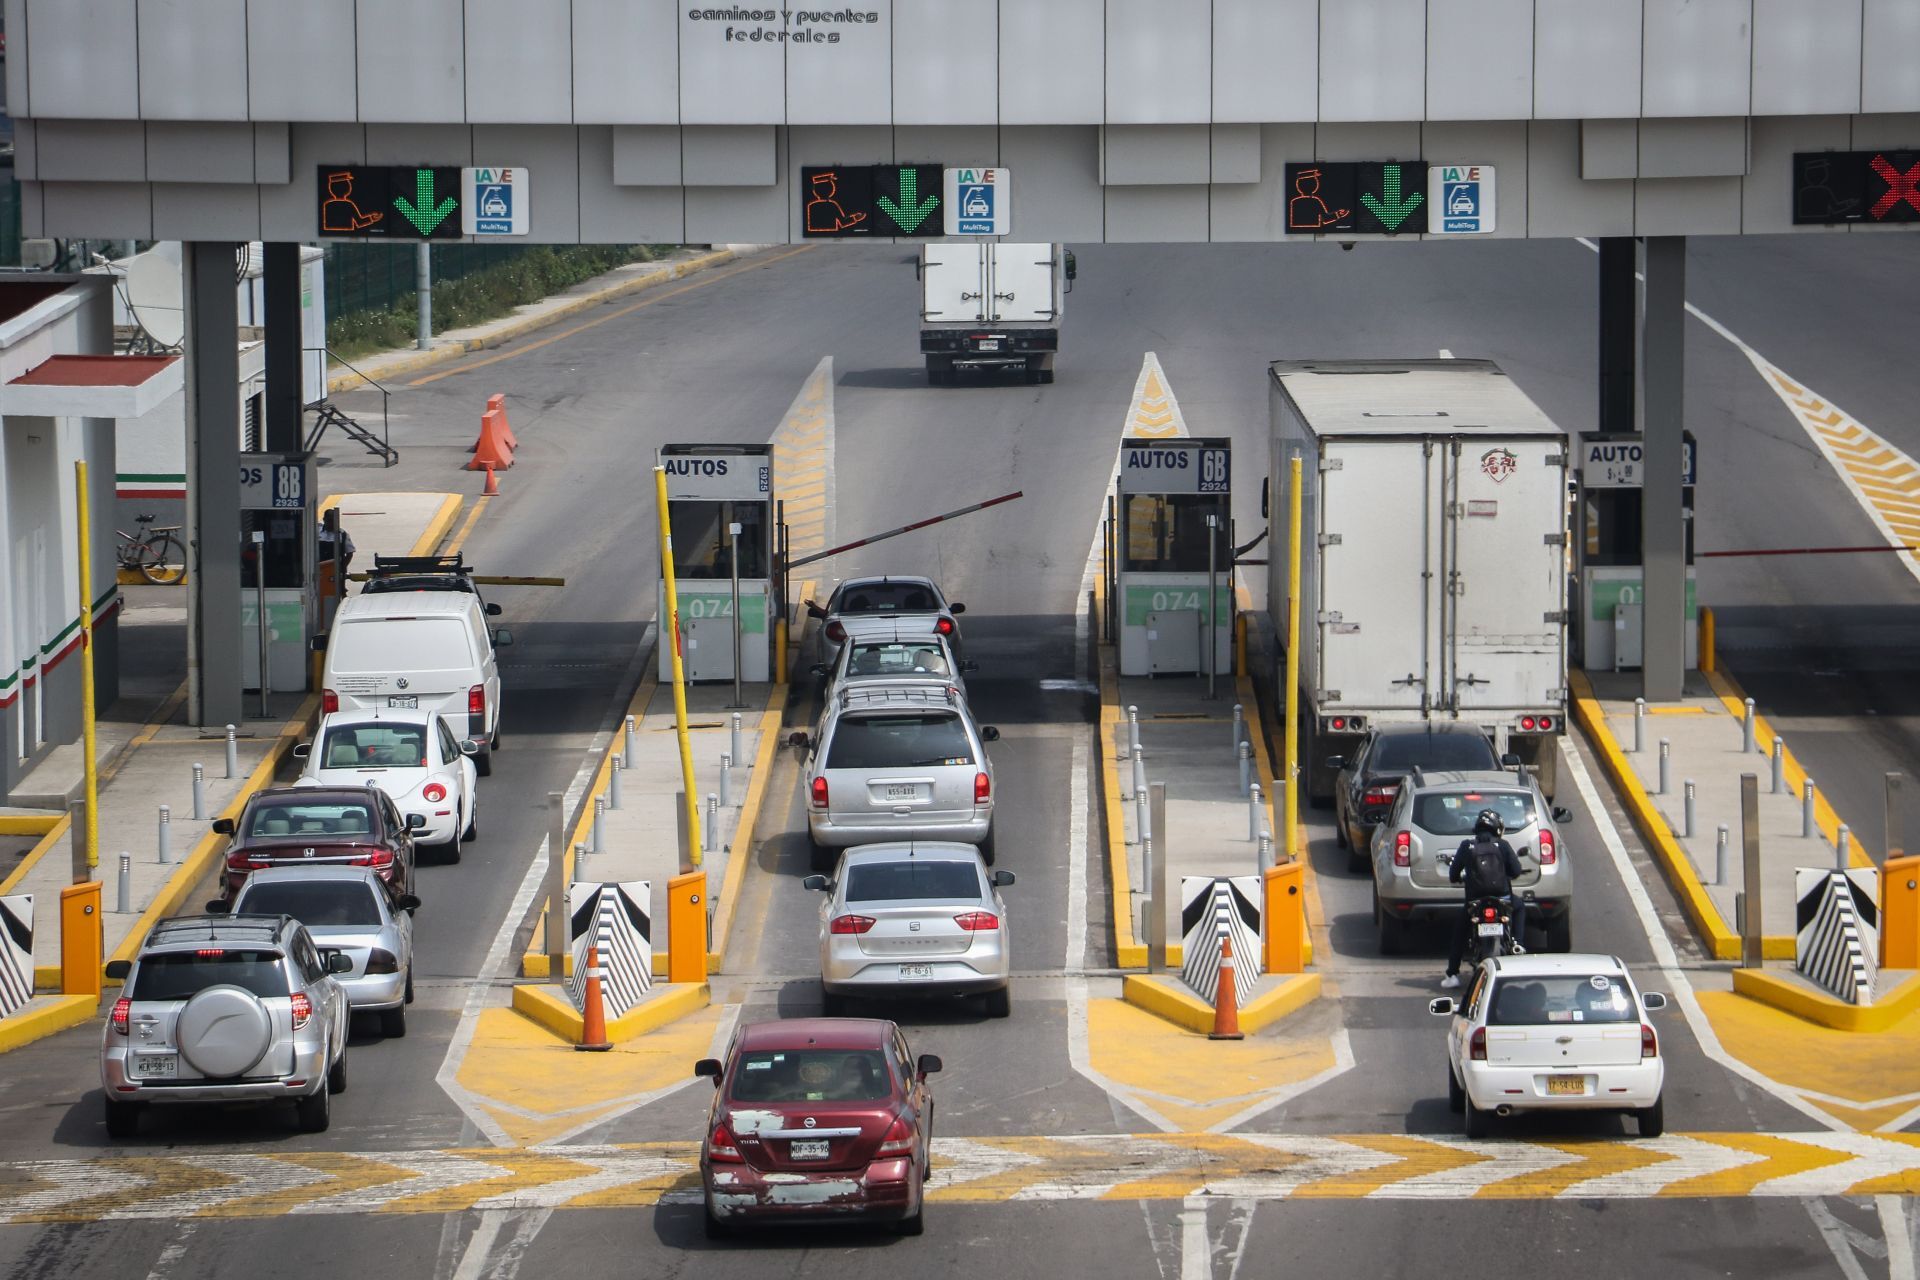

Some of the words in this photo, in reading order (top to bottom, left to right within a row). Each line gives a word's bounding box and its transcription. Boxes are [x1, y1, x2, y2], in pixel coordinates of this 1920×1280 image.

[689, 5, 776, 22] caminos
[796, 8, 879, 26] puentes
[725, 26, 841, 44] federales
[476, 169, 512, 183] IAVE
[958, 169, 994, 183] IAVE
[1443, 167, 1479, 181] IAVE
[1128, 450, 1189, 469] AUTOS
[1590, 446, 1643, 462] AUTO
[665, 459, 728, 476] AUTOS
[1203, 450, 1226, 482] 6B
[278, 465, 301, 499] 8B
[760, 467, 768, 492] 2925
[1200, 482, 1228, 491] 2924
[275, 498, 299, 507] 2926
[1152, 591, 1201, 611] 074
